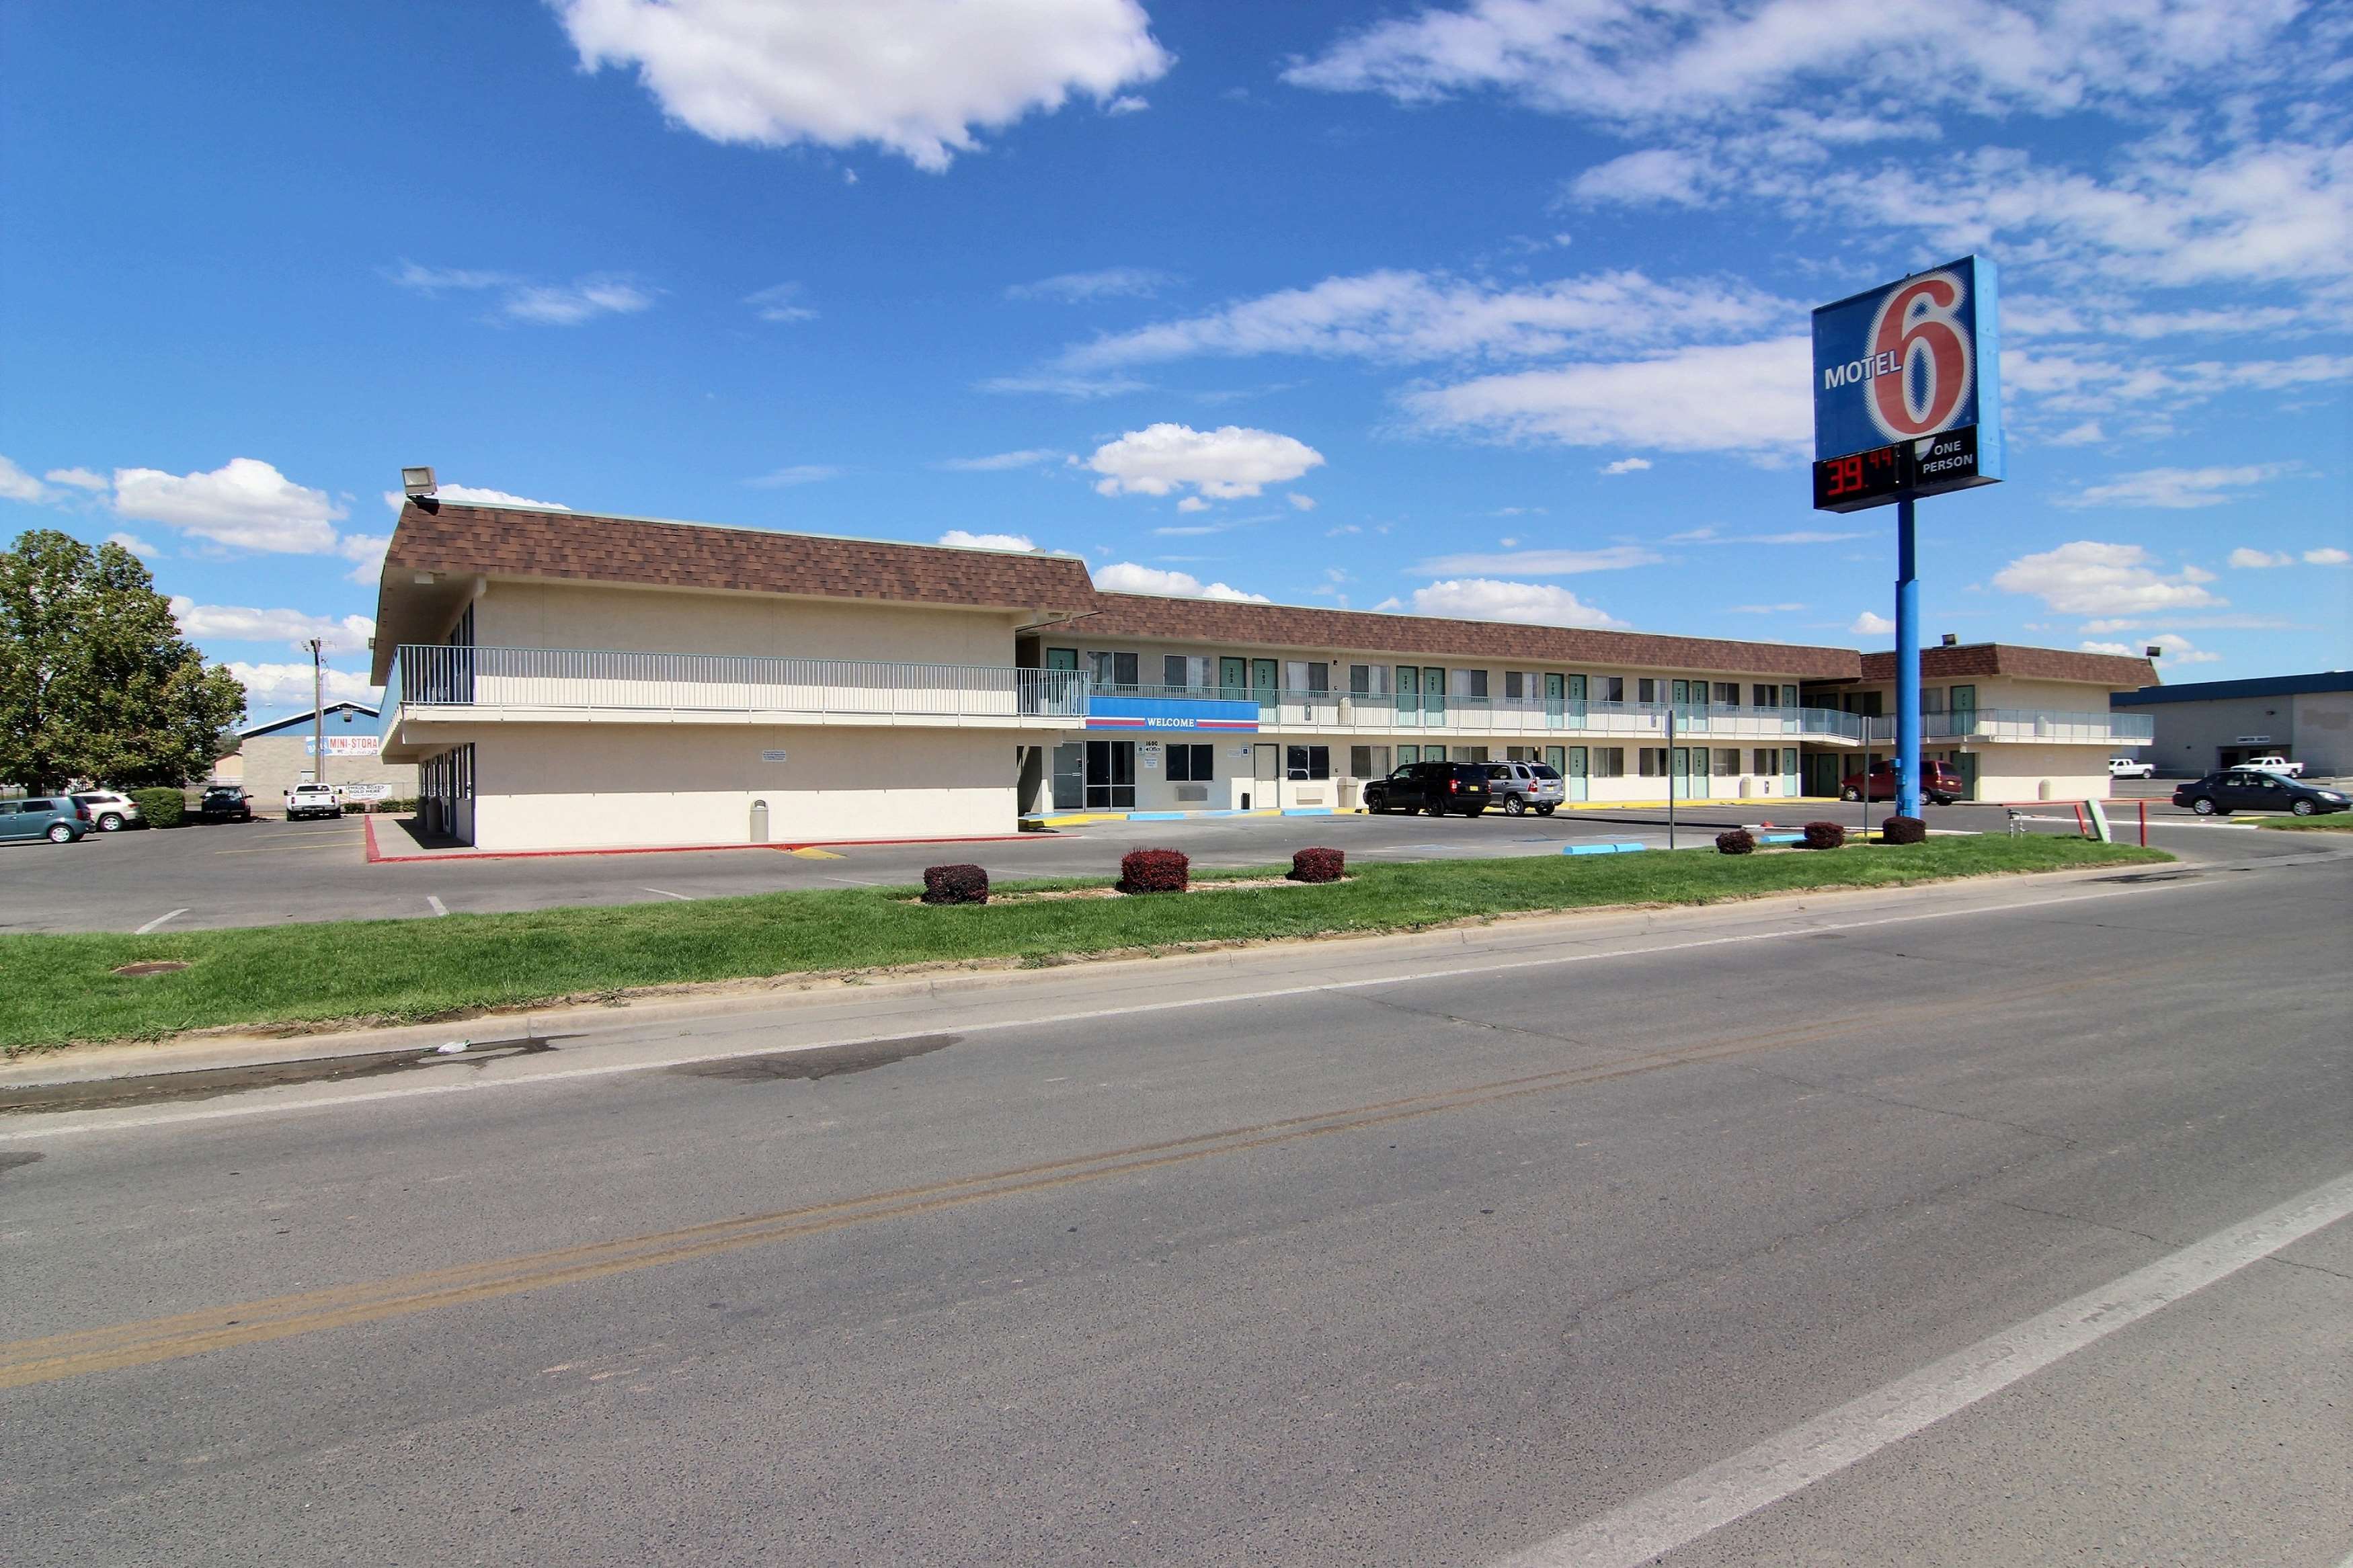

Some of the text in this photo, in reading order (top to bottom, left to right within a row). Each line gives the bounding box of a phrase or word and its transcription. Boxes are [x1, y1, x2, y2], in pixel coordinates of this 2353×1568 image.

[1825, 279, 1964, 435] MOTEL 6
[1934, 440, 1962, 456] ONE
[1923, 454, 1973, 474] PERSON
[1147, 718, 1195, 727] WELCOME
